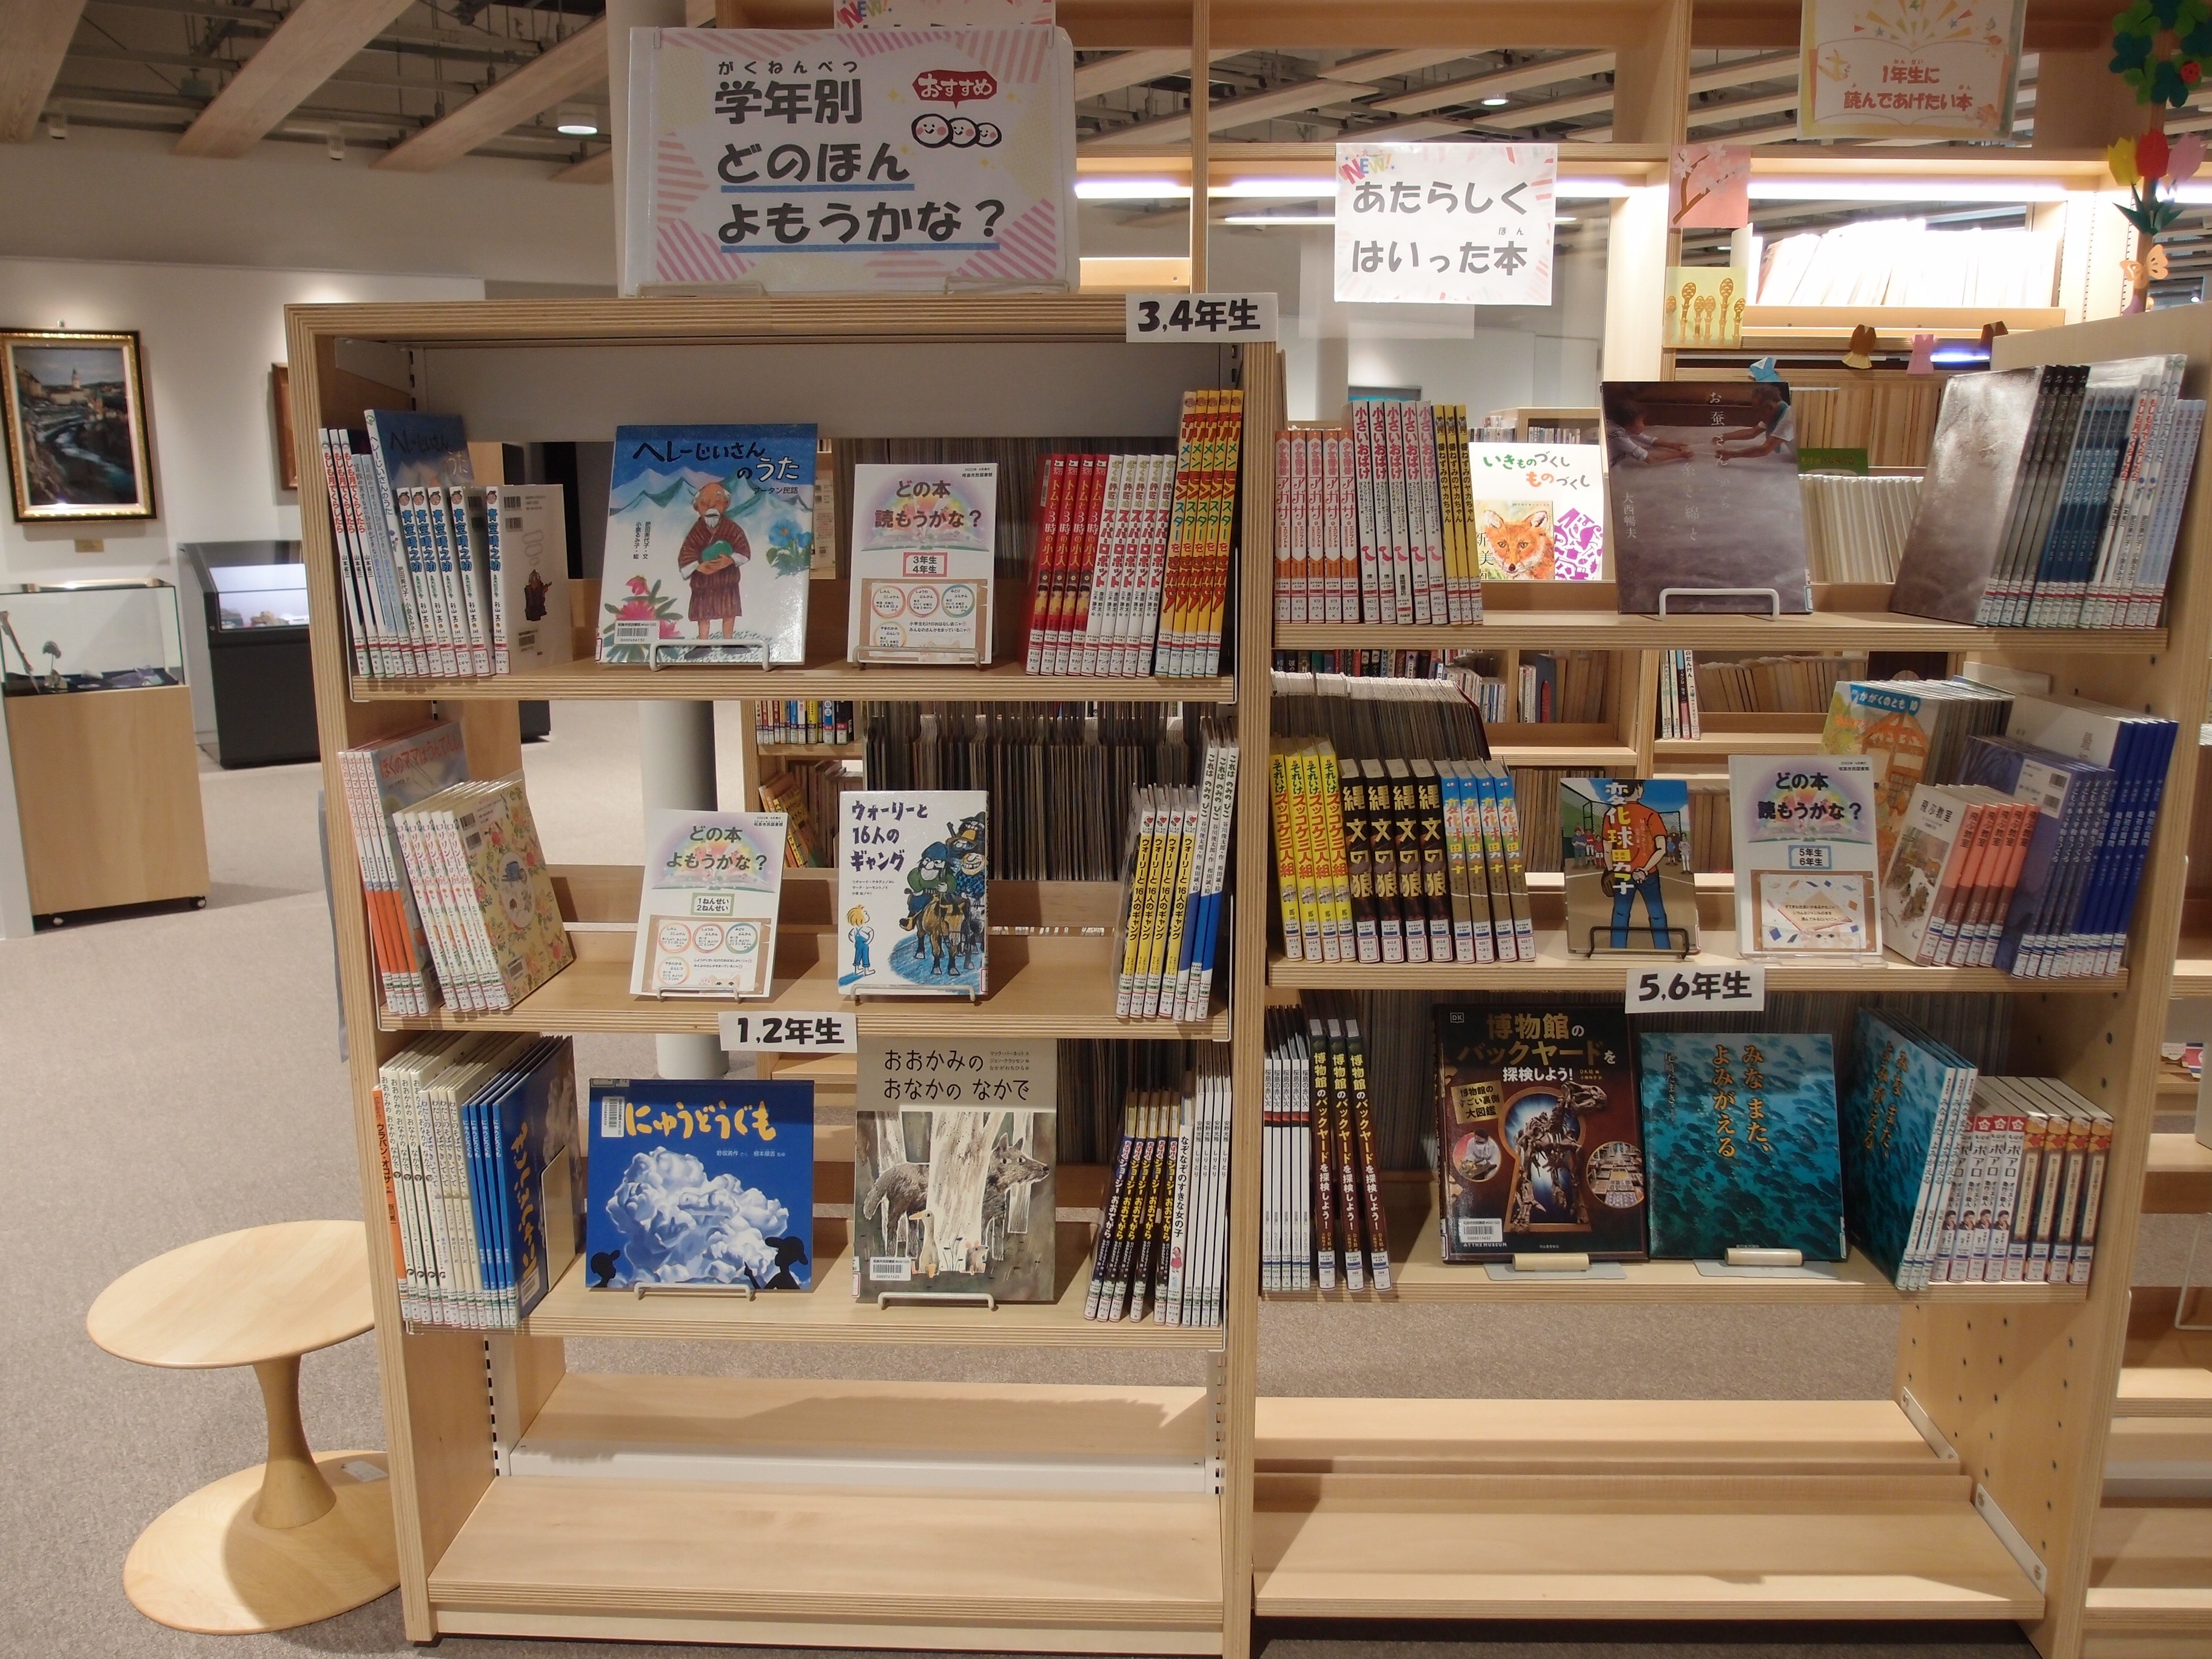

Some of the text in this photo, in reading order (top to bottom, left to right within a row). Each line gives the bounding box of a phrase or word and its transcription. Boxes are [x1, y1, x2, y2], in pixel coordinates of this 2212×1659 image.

[718, 61, 858, 75] がくねんべつ
[919, 74, 993, 98] おすすめ
[1882, 65, 1940, 84] 1年生に
[715, 79, 862, 124] 学年別
[1844, 91, 1973, 111] 読んであげたい本
[718, 143, 910, 183] どのほん
[1339, 154, 1391, 184] NEW!
[1353, 181, 1528, 215] あたらしく
[718, 200, 1005, 244] よもうかな？
[1498, 227, 1524, 236] ほん
[1352, 240, 1527, 276] はいった本
[1138, 298, 1261, 332] 3,4年生
[1355, 407, 1370, 480] 小さいおばけ
[1372, 407, 1387, 480] 小さいおばけ
[1387, 407, 1403, 480] 小さいおばけ
[1403, 407, 1419, 480] 小さいおばけ
[1419, 407, 1435, 480] 小さいおばけ
[1483, 451, 1570, 470] いきものづくし
[737, 456, 800, 482] のうた
[896, 480, 951, 498] どの本
[1437, 443, 1452, 523] 番ねずみのヤカちゃん
[1449, 443, 1463, 523] 番ねずみのヤカちゃん
[1460, 443, 1474, 523] 番ねずみのヤカちゃん
[1526, 471, 1590, 490] ものづくし
[325, 452, 343, 533] もしも月でくらしたら
[335, 452, 355, 533] もしも月でくらしたら
[345, 452, 366, 533] もしも月でくらしたら
[753, 486, 799, 495] ブータン民話
[1681, 463, 1700, 541] 糸と綿と
[874, 509, 982, 529] 読もうかな？
[1041, 480, 1060, 567] トムと3時の小人
[1055, 480, 1074, 567] トムと3時の小人
[1070, 480, 1089, 567] トムと3時の小人
[1084, 480, 1102, 567] トムと3時の小人
[402, 509, 422, 572] 青空晴之助
[416, 509, 436, 572] 青空晴之助
[432, 509, 452, 572] 青空晴之助
[913, 556, 937, 565] 3年生
[912, 565, 937, 574] 4年生
[1859, 691, 1905, 709] かがくのとも
[340, 757, 361, 837] ぼくのママはうんてんし
[348, 757, 369, 837] ぼくのママはうんてんし
[357, 757, 377, 837] ぼくのママはうんてんし
[1775, 773, 1828, 790] どの本
[851, 800, 928, 821] ウォーリーと
[1273, 763, 1295, 879] それいけズッコケ三人組
[1290, 763, 1314, 879] それいけズッコケ三人組
[1307, 763, 1330, 879] それいけズッコケ三人組
[1324, 763, 1348, 879] それいけズッコケ三人組
[1758, 801, 1862, 821] 読もうかな？
[689, 825, 743, 842] どの本
[852, 825, 900, 845] 16人の
[1343, 785, 1373, 897] 縄文の狼
[1368, 785, 1398, 897] 縄文の狼
[1393, 785, 1423, 897] 縄文の狼
[1418, 785, 1447, 897] 縄文の狼
[1798, 848, 1823, 857] 5年生
[666, 852, 768, 871] よもうかな？
[850, 850, 906, 873] ギャング
[1798, 857, 1823, 866] 6年生
[1129, 839, 1150, 940] ウォーリーと 16人のギャング
[1142, 839, 1163, 940] ウォーリーと 16人のギャング
[1156, 887, 1171, 940] 16人のギャング
[1638, 971, 1752, 1002] 5,6年生
[737, 1017, 845, 1045] 1,2年生
[1486, 1013, 1585, 1040] 博物館の
[885, 1049, 984, 1072] おおかみの
[1457, 1040, 1617, 1066] バックヤードを
[883, 1078, 1030, 1101] おなかの なかで
[1460, 1085, 1493, 1097] 博物館の
[1712, 1045, 1736, 1158] よみがえる
[625, 1099, 777, 1141] にゅうどうぐも
[1466, 1107, 1497, 1118] 大図鑑
[1115, 1159, 1127, 1193] ジョージー
[1971, 1145, 1986, 1177] ポアロ
[1987, 1144, 2004, 1176] ポアロ
[2005, 1145, 2021, 1177] ポアロ
[1116, 1161, 1139, 1240] ジョージー おおてがら
[1128, 1161, 1151, 1240] ジョージー おおてがら
[1173, 1136, 1190, 1238] なぞなぞのすきな女の子
[1104, 1196, 1120, 1238] おおてがら
[1144, 1196, 1157, 1239] おおてがら
[1162, 1198, 1174, 1241] おおてがら
